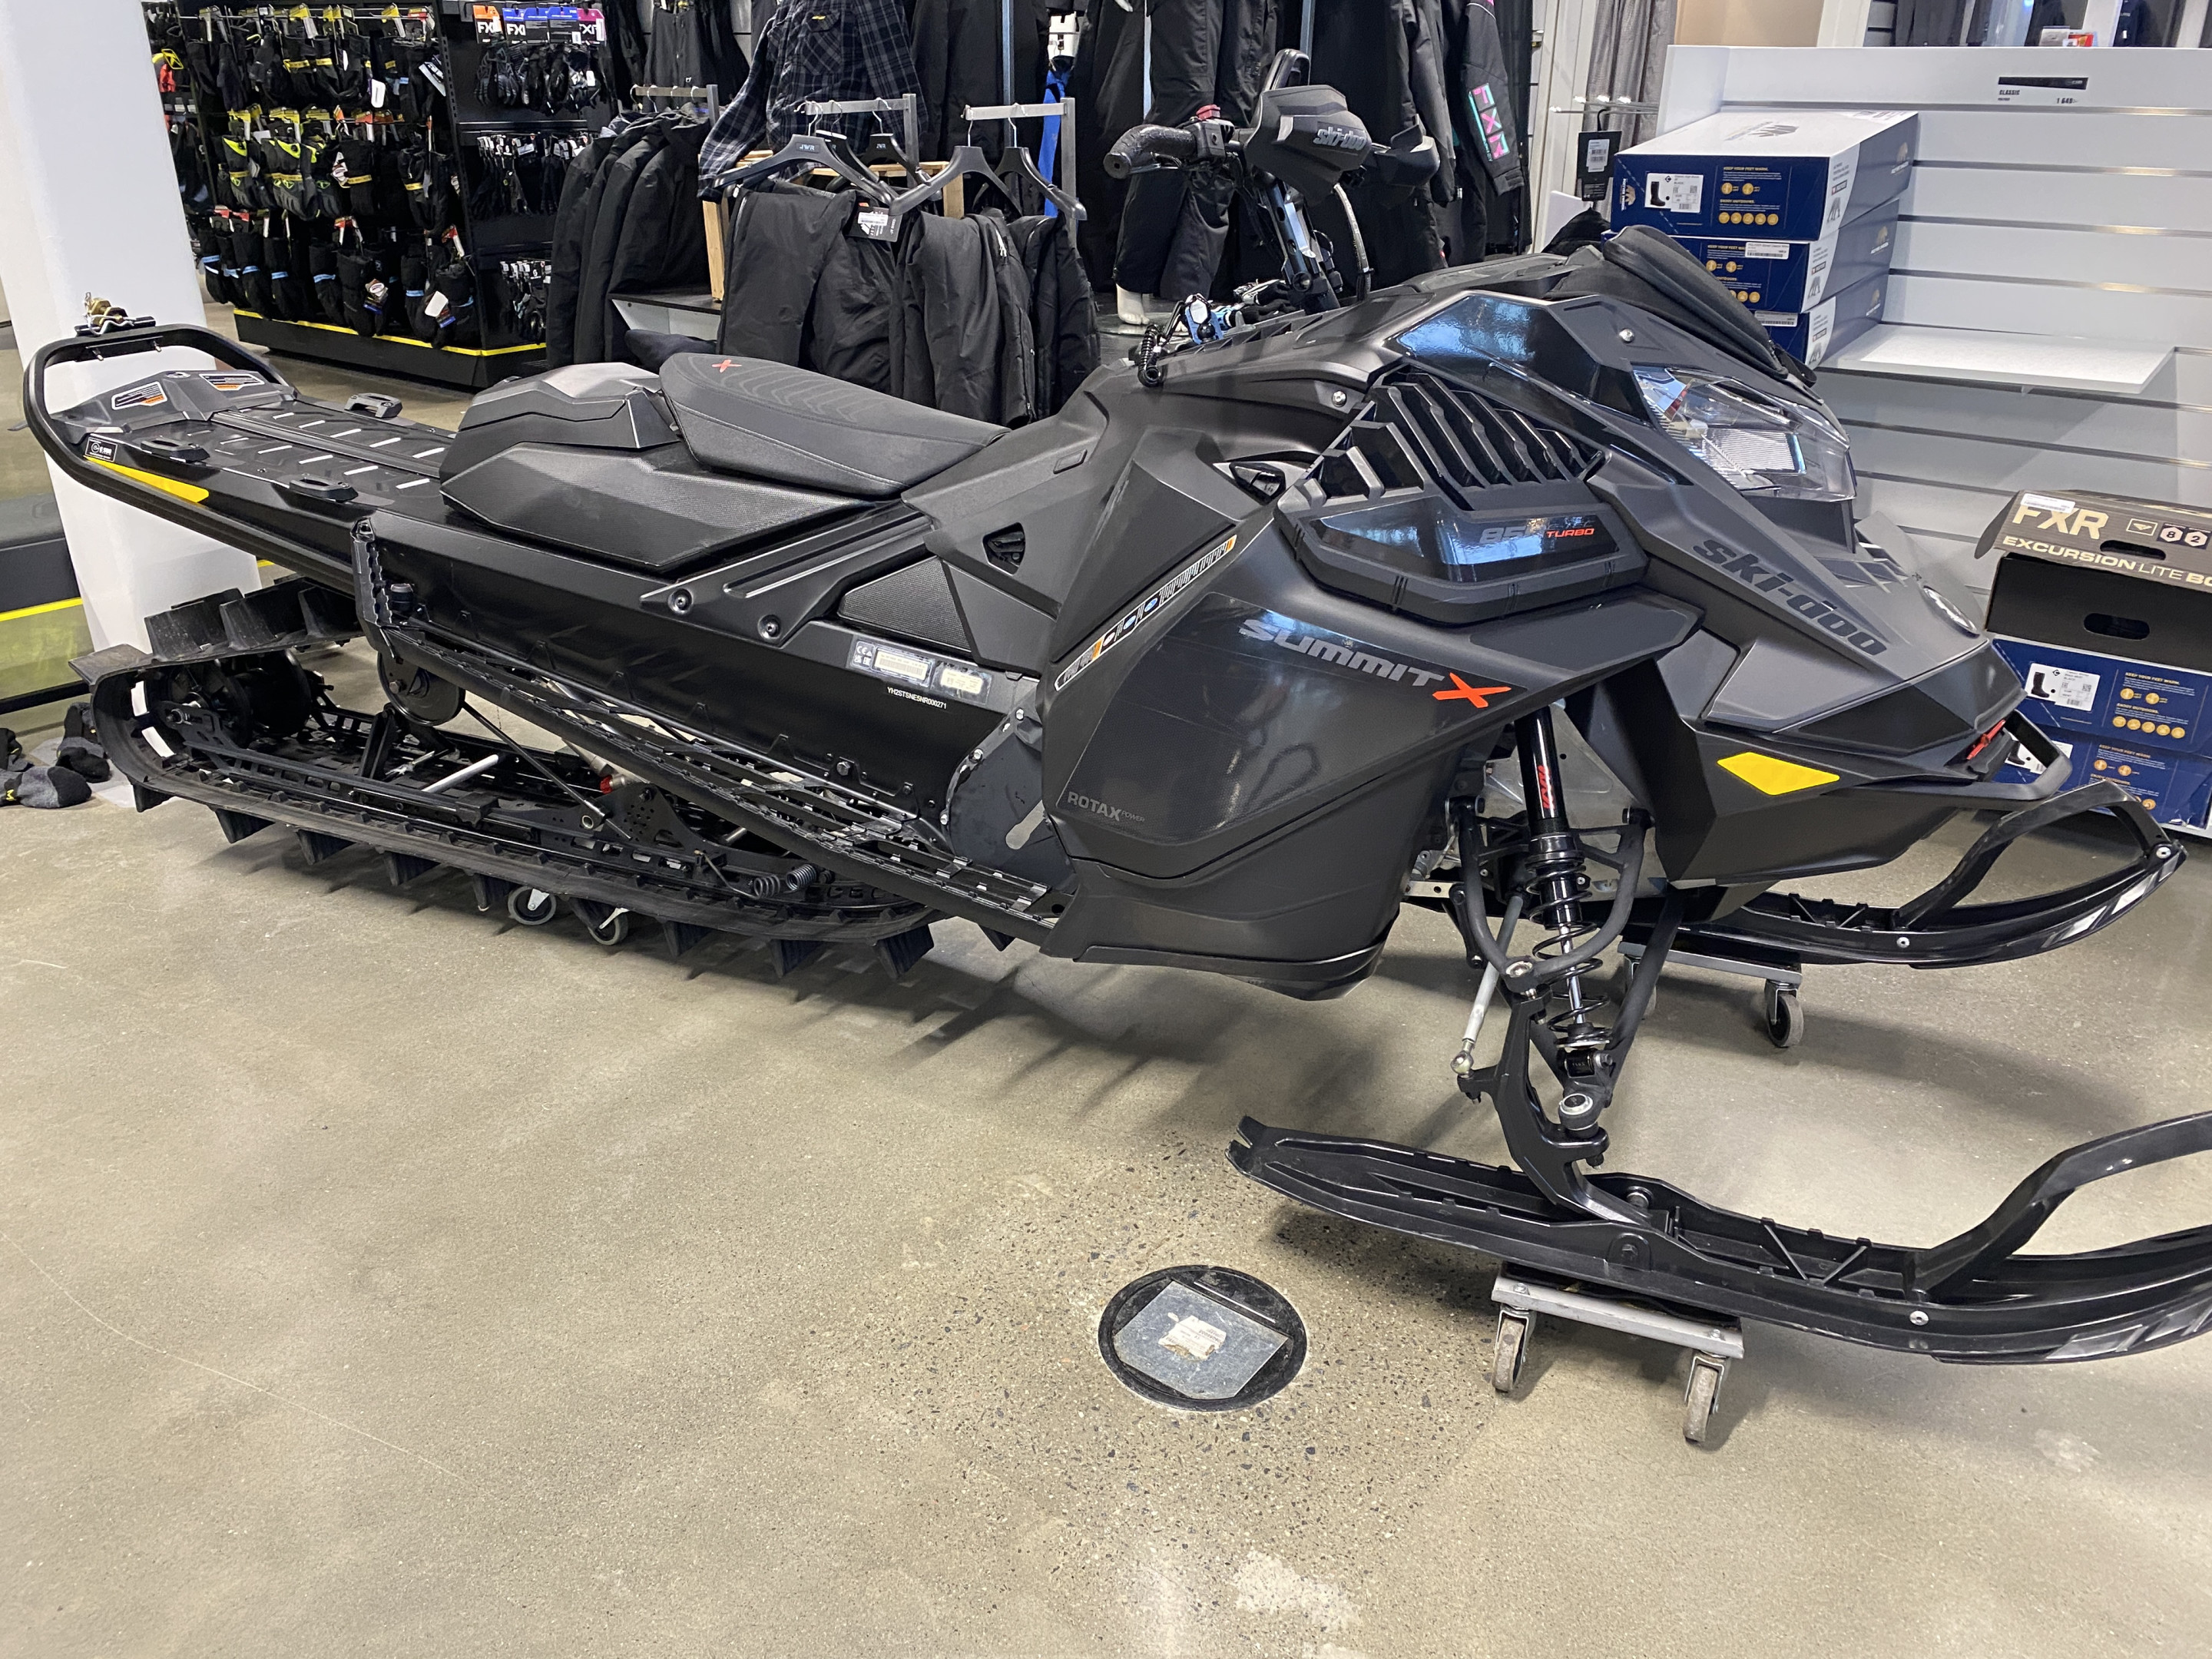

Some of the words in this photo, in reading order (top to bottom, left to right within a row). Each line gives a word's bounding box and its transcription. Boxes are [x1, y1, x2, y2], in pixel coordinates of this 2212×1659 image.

[1472, 83, 1510, 160] FXR
[1546, 528, 1594, 538] TURBO
[2012, 504, 2109, 540] FXR
[2166, 530, 2175, 539] 8
[2191, 535, 2200, 544] 2
[2002, 535, 2136, 571] EXCURSION
[2138, 563, 2184, 581] LITE
[1238, 619, 1445, 687] SUMMIT
[1432, 672, 1512, 708] X
[1068, 791, 1121, 822] ROTAX
[1121, 810, 1145, 823] POWER
